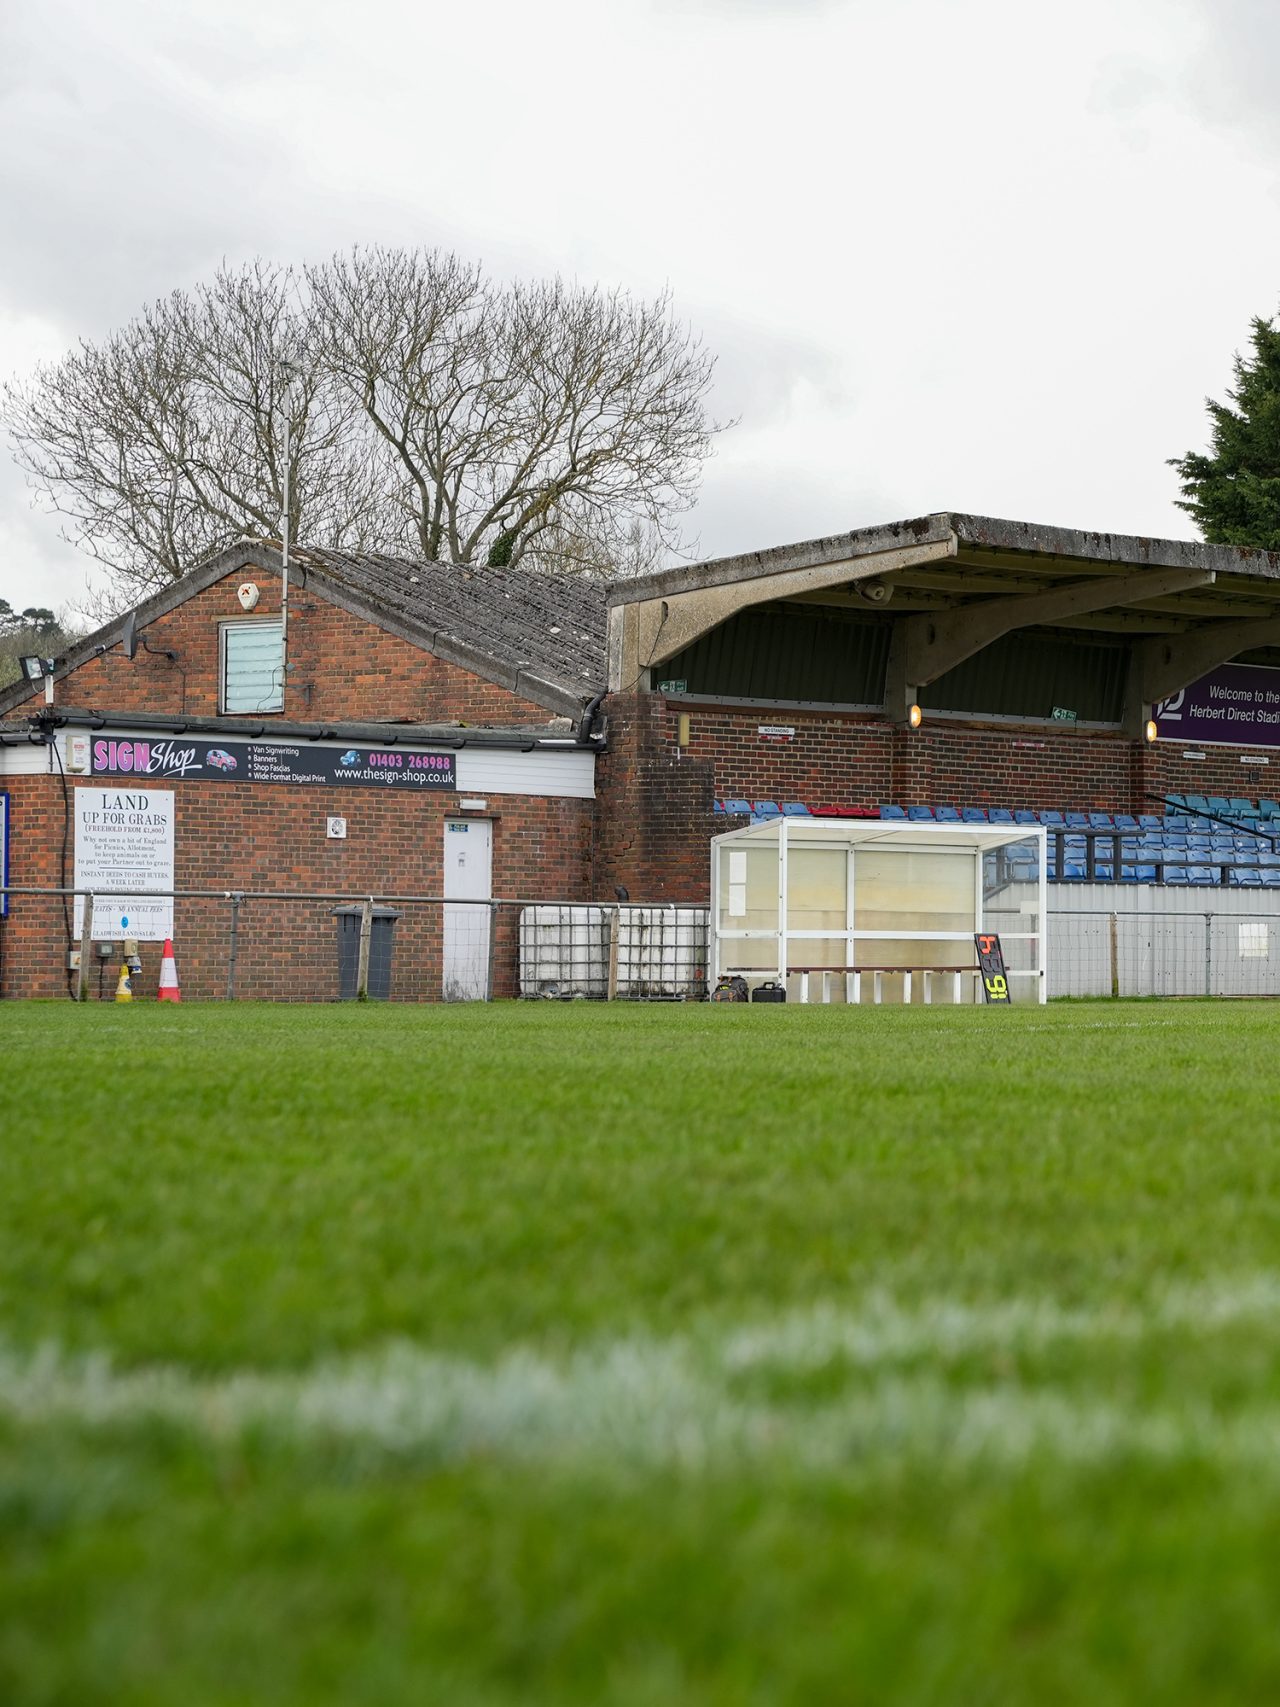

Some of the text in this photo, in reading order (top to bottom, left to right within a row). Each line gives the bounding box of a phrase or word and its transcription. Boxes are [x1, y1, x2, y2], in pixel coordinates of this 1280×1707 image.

[1209, 685, 1280, 704] Welcome to the
[1189, 704, 1226, 720] Herbert
[1227, 707, 1256, 722] Direct
[93, 740, 203, 777] SIGN Shop
[253, 746, 300, 757] Van Signwriting
[253, 755, 278, 763] Banners
[253, 763, 291, 773] Shop Fascias
[369, 752, 450, 770] 01403 268988
[253, 772, 326, 784] Wide Format Digital Print
[334, 766, 455, 785] www.thesign-shop.co.uk
[101, 793, 149, 811] LAND
[82, 811, 167, 826] UP FOR GRABS
[84, 823, 123, 833] (FREEHOLD
[123, 826, 142, 834] FROM
[83, 836, 96, 844] Why
[143, 837, 167, 845] England
